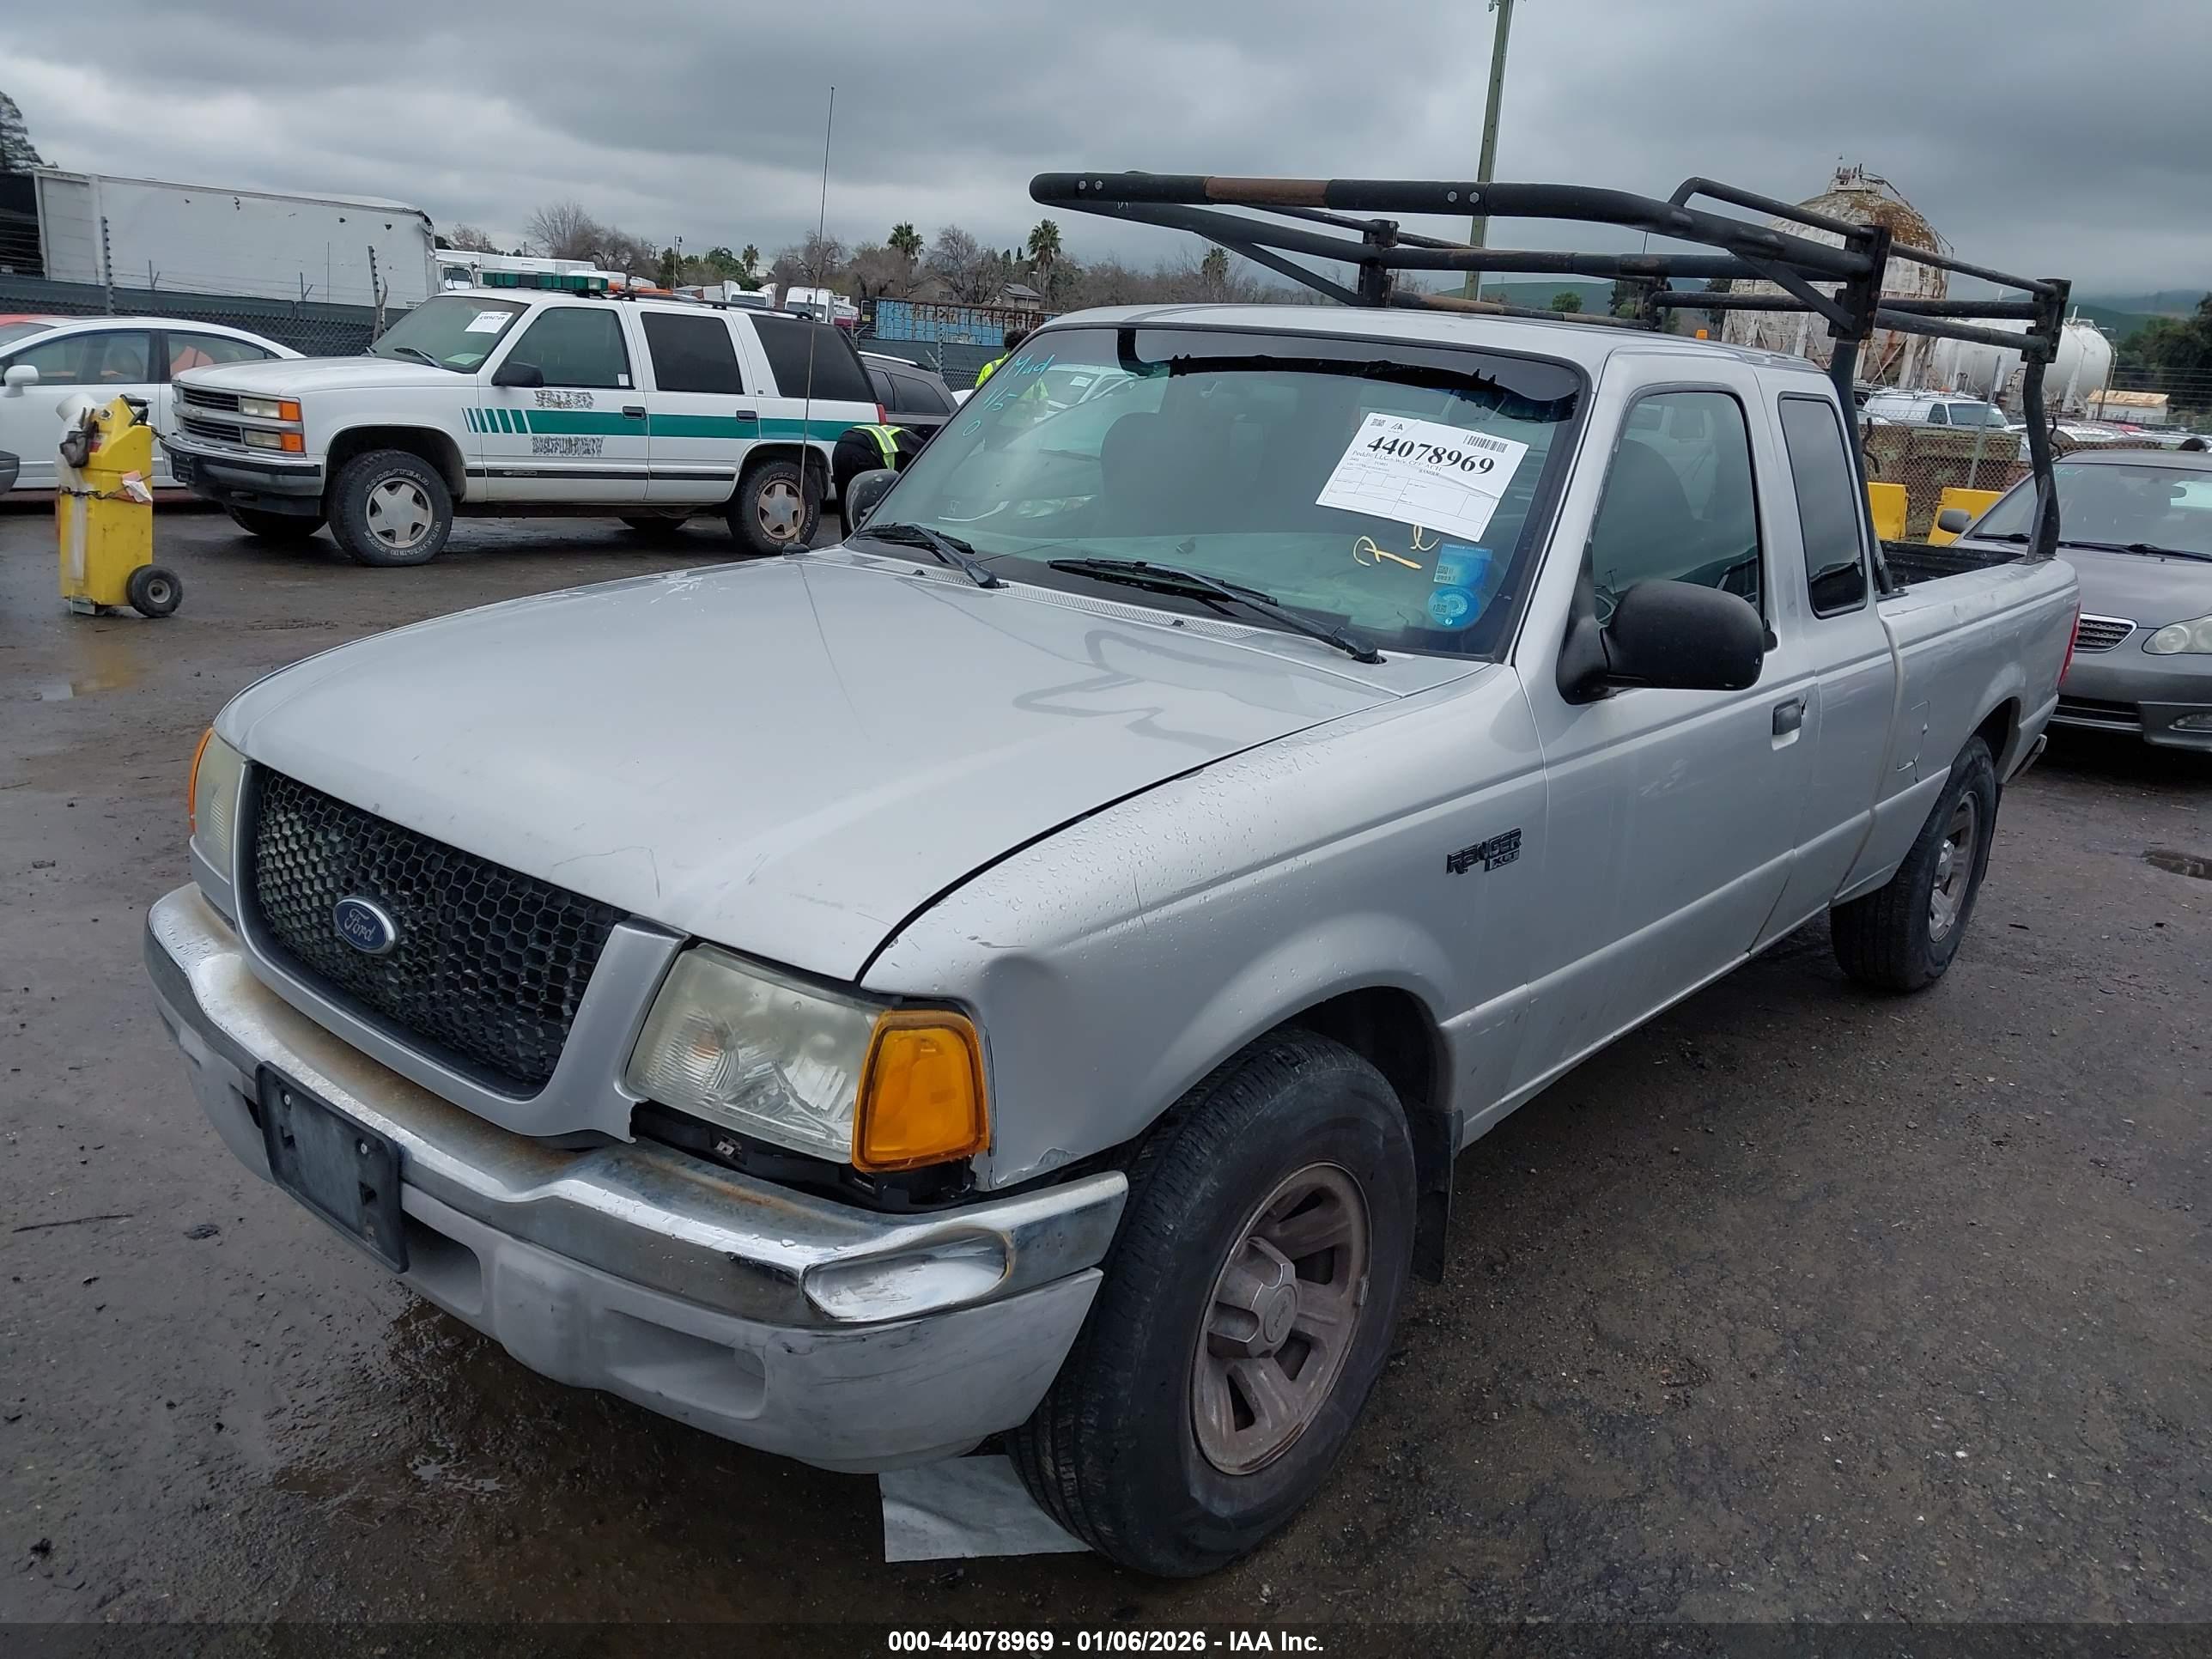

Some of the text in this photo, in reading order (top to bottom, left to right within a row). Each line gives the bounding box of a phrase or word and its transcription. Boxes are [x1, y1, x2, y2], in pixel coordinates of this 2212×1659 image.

[1367, 436, 1495, 475] 44078969
[1446, 828, 1522, 874] RANGER
[1491, 850, 1516, 868] XLT
[344, 908, 376, 942] Ford
